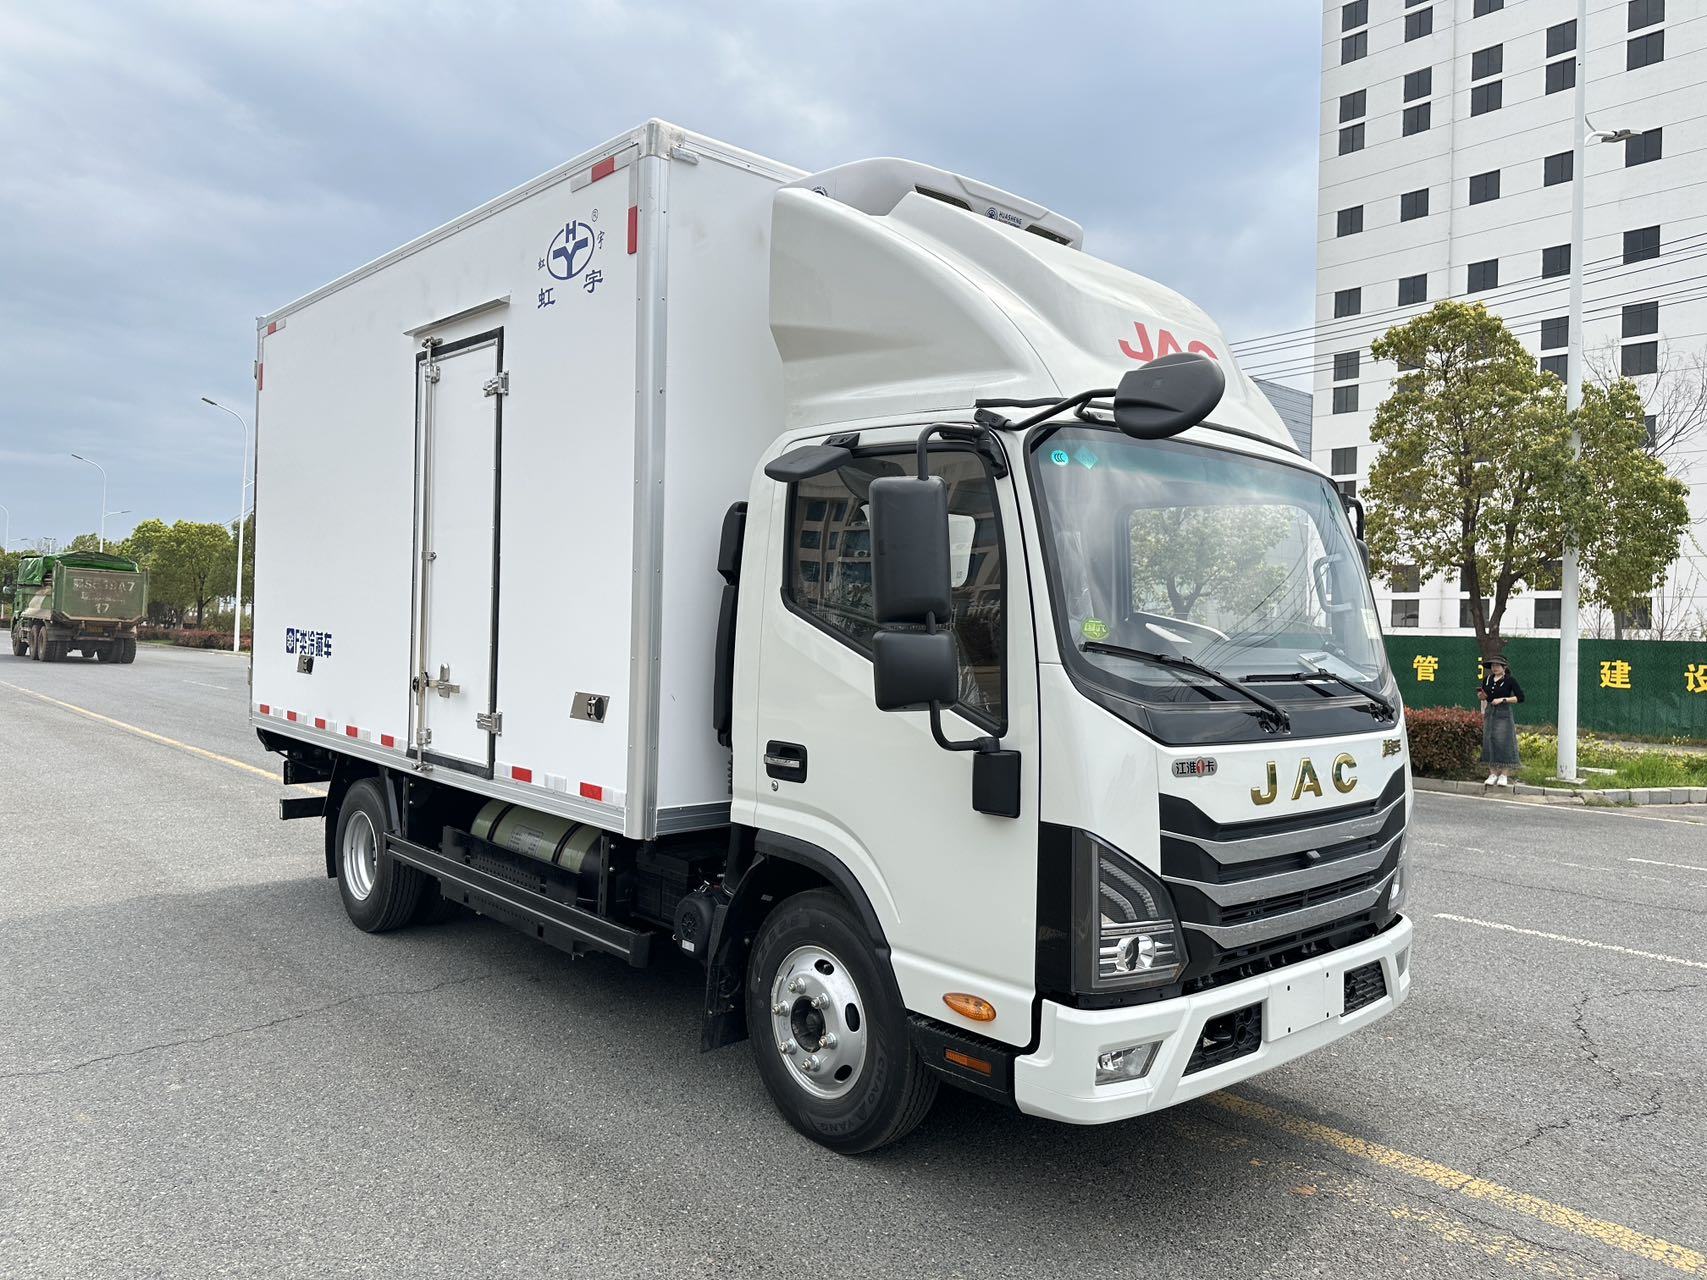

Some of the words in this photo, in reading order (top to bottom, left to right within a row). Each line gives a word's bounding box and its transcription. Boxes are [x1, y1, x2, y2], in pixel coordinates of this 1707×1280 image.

[295, 629, 332, 658] F类冷藏车
[1250, 752, 1358, 806] JAC
